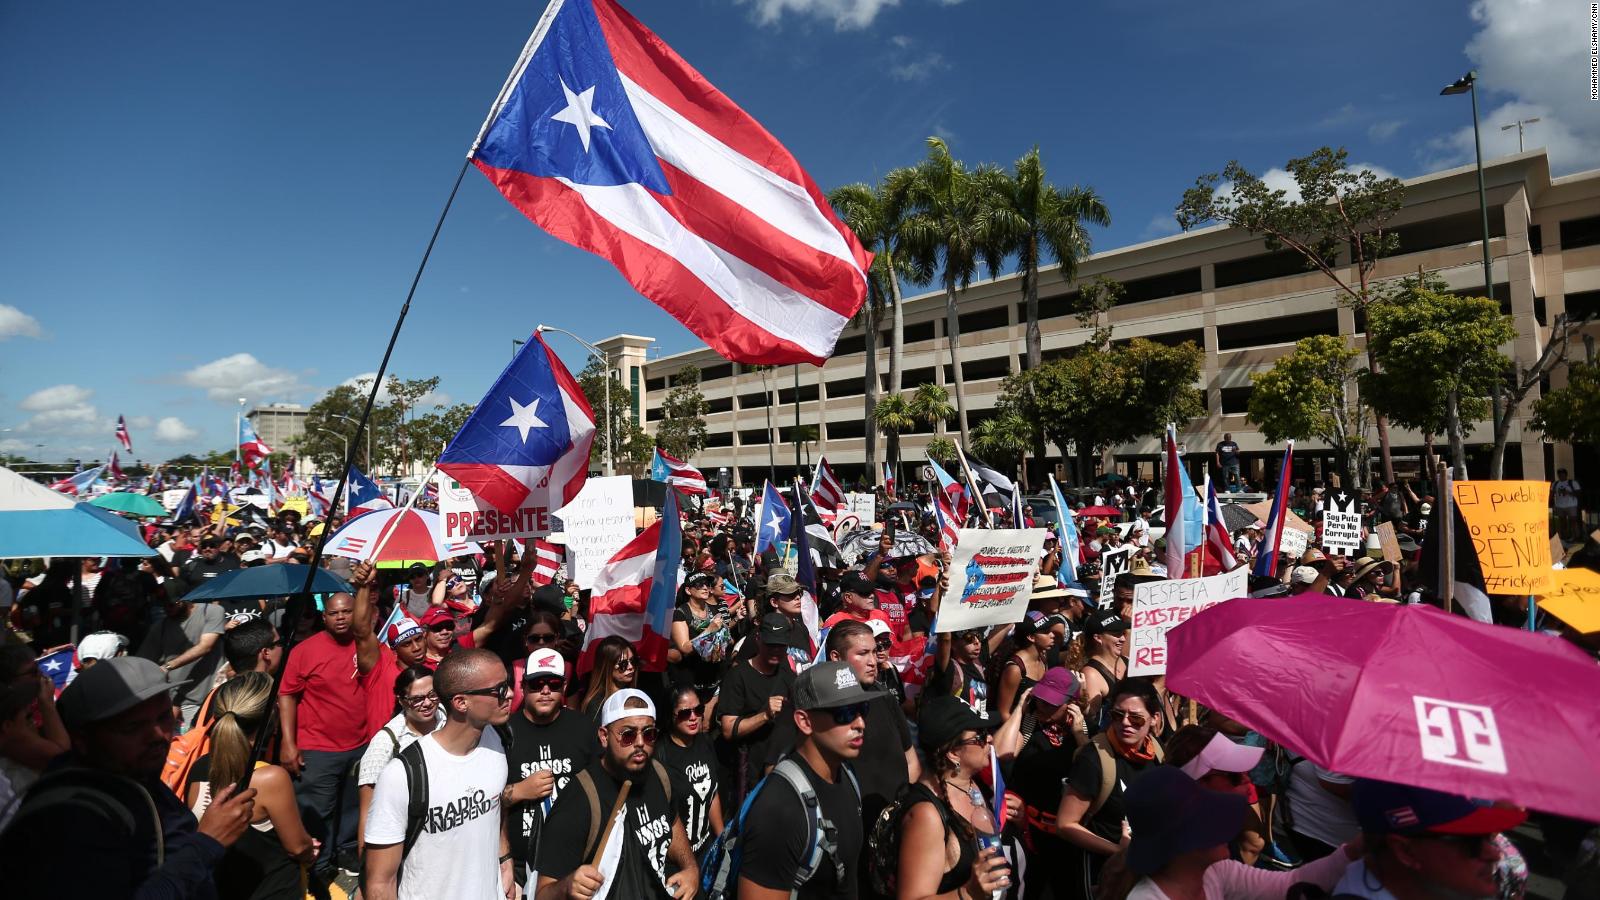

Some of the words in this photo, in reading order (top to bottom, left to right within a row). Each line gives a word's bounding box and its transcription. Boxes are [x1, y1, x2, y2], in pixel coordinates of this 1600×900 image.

[1456, 485, 1479, 505] El
[446, 507, 549, 537] PRESENTE
[1326, 513, 1340, 522] Soy
[1341, 514, 1358, 523] Puta
[1327, 521, 1346, 530] Pero
[1325, 529, 1359, 539] Corrupta
[1488, 523, 1516, 534] nos
[1136, 580, 1209, 607] RESPETA
[1223, 575, 1241, 594] MI
[1135, 647, 1167, 668] RE
[685, 760, 711, 782] Ricky
